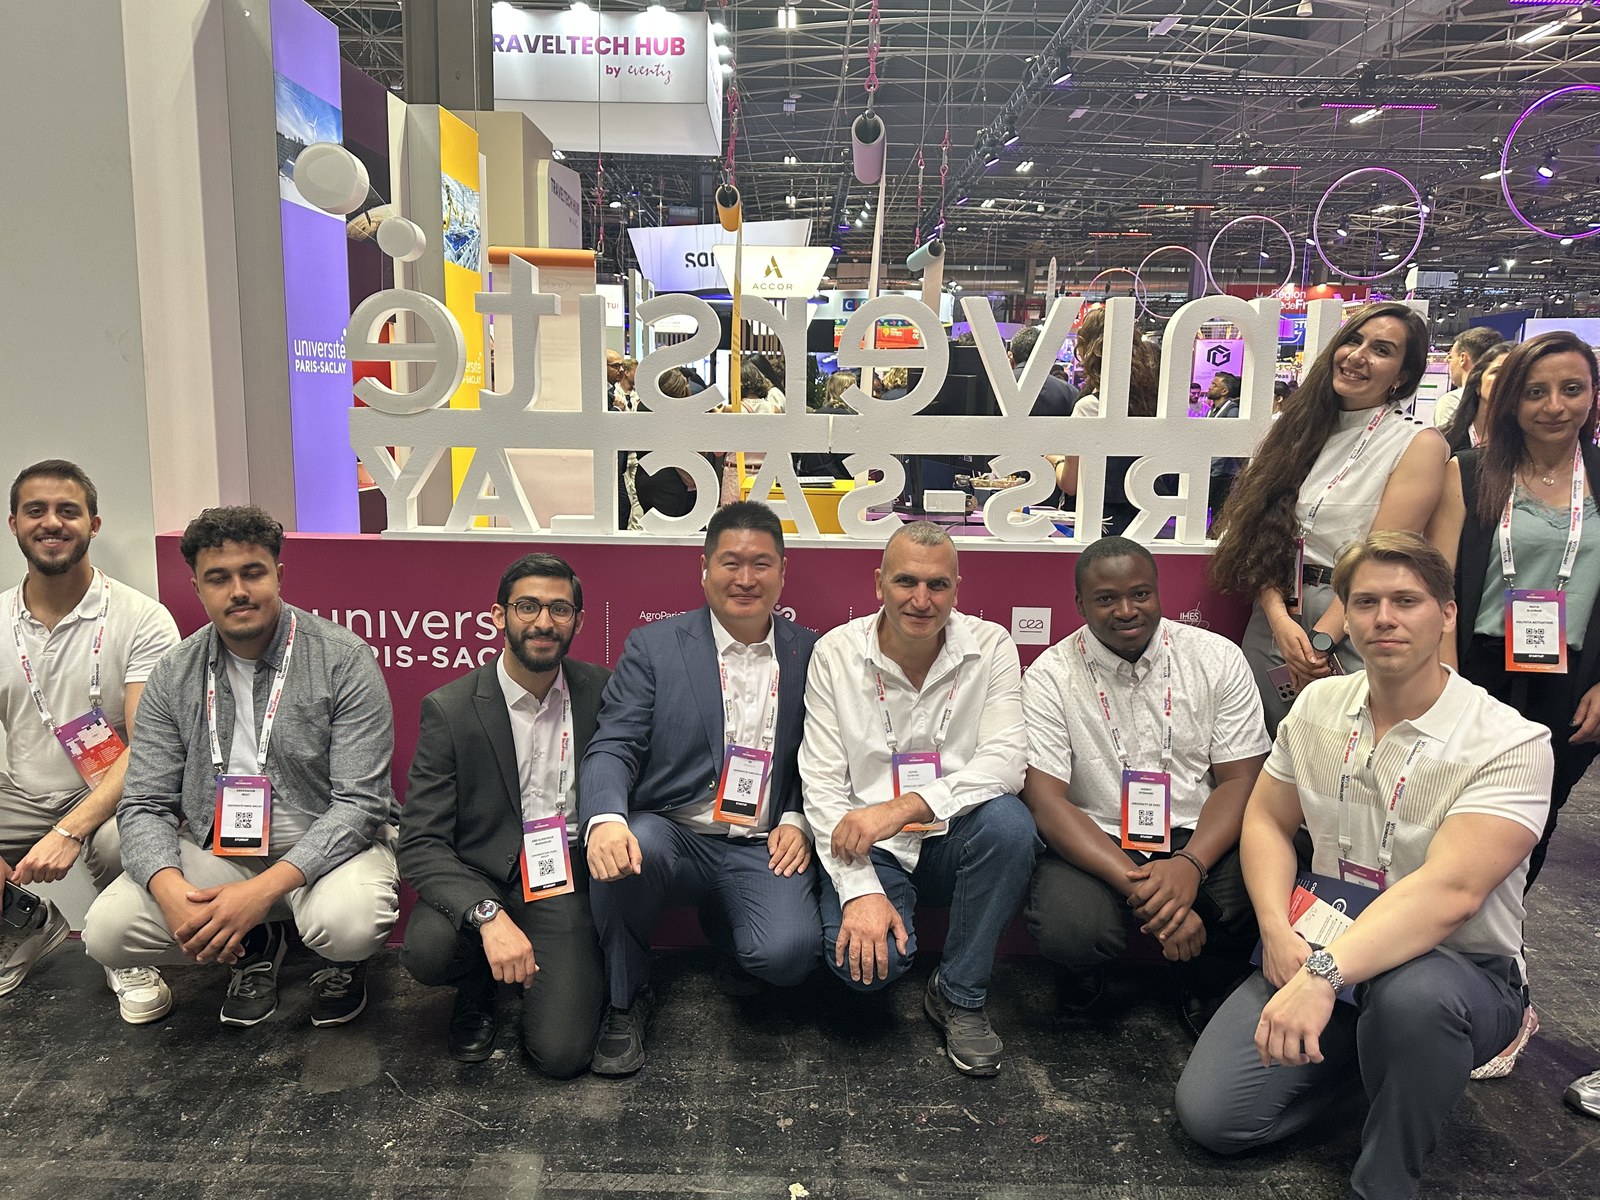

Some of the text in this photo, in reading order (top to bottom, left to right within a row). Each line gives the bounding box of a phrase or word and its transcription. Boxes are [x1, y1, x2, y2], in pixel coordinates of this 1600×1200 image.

[492, 34, 685, 56] RAVELTECH HUB
[606, 65, 621, 78] by
[295, 359, 347, 374] PARIS-SACLAY
[1180, 612, 1199, 620] IHES
[1018, 617, 1044, 630] cea
